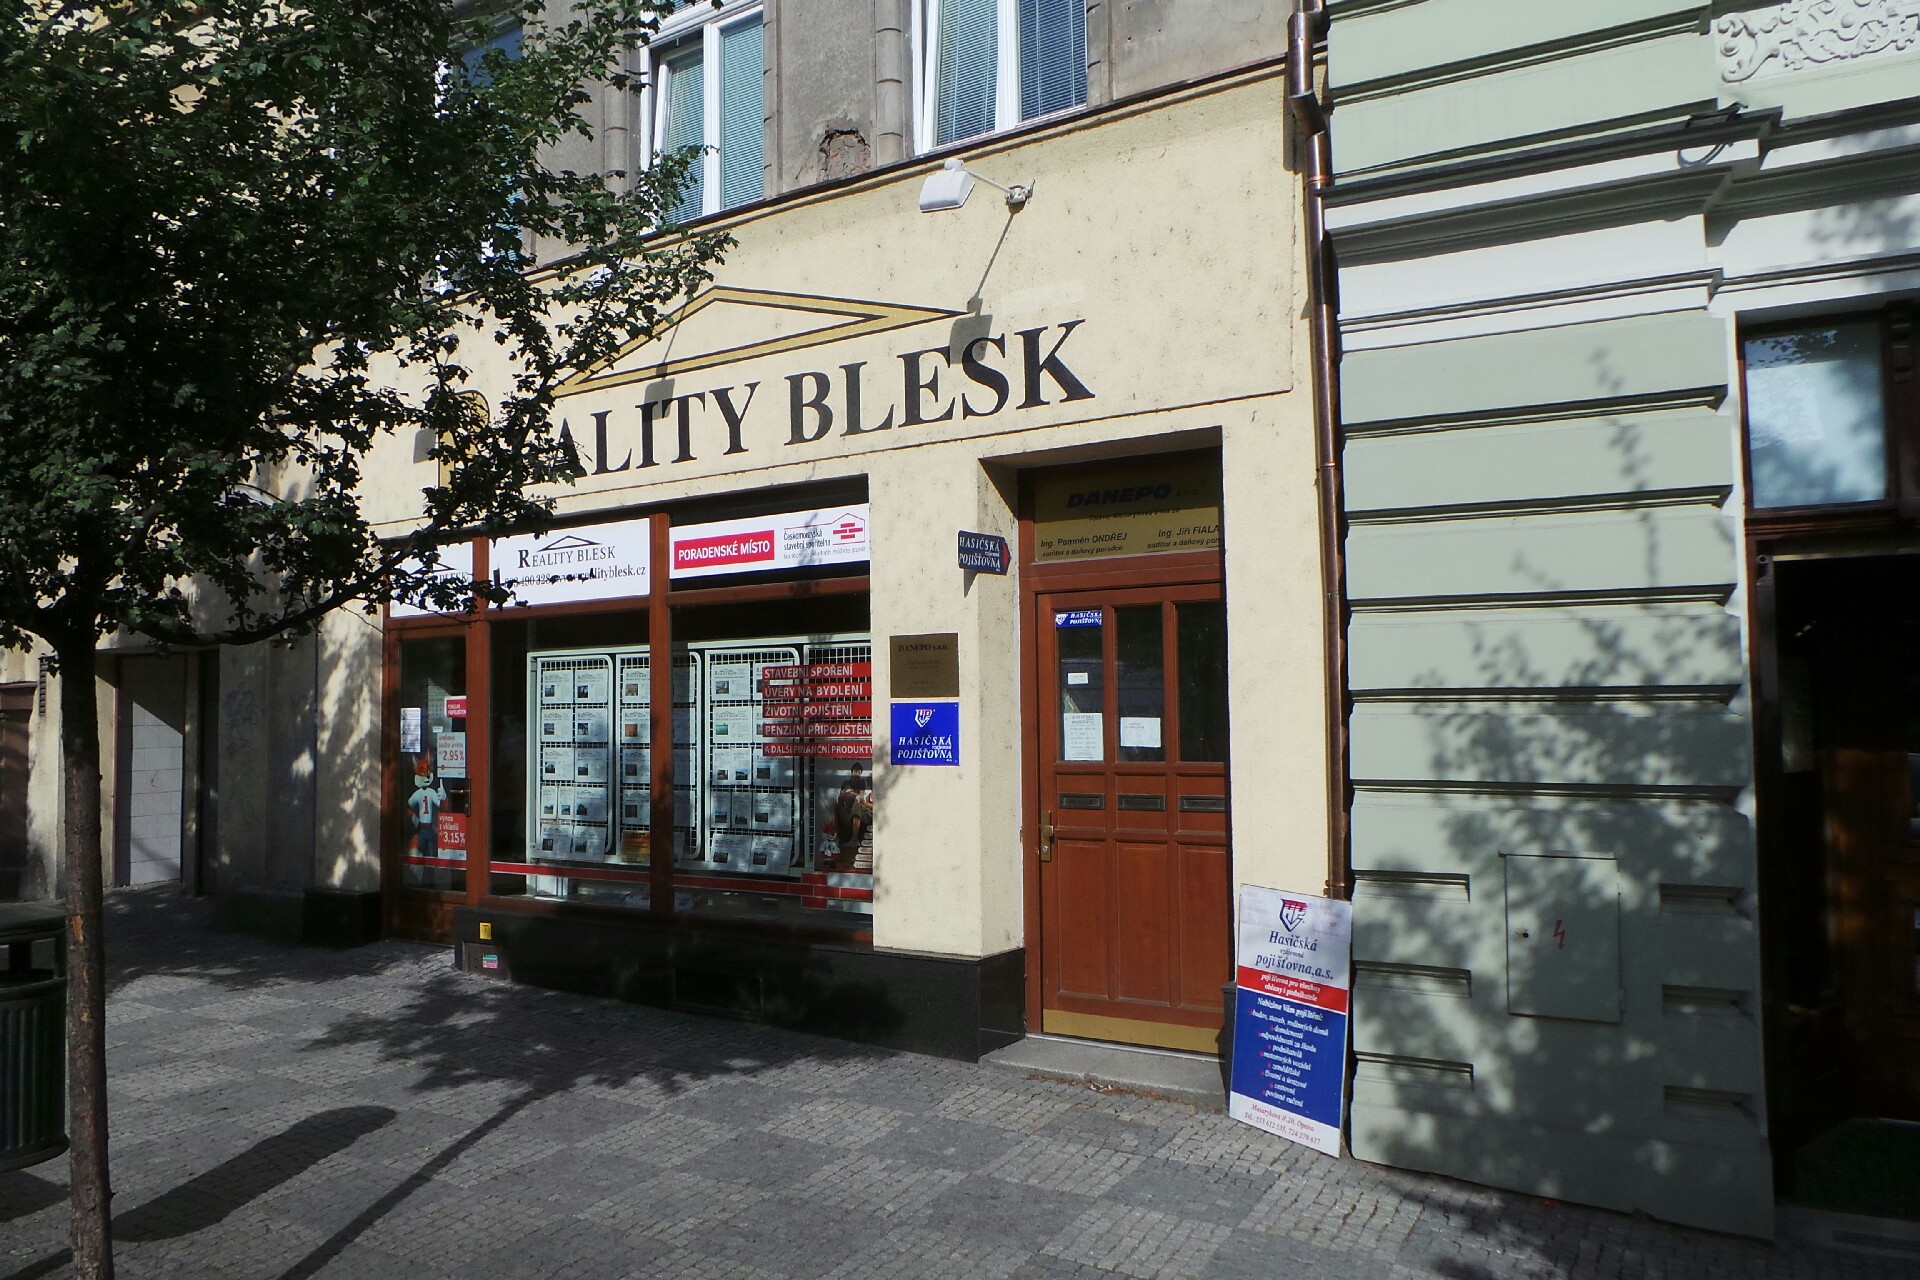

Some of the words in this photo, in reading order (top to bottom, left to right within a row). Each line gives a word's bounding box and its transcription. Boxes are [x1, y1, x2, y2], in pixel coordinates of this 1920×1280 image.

[784, 318, 1096, 446] BLESK
[1066, 484, 1172, 508] DANEPO
[1158, 529, 1174, 539] Ing.
[1176, 527, 1190, 536] Jiří
[1192, 524, 1220, 534] FIALA
[783, 540, 804, 551] stavební
[959, 536, 1000, 552] HASIČSKÁ
[1040, 539, 1055, 549] Ing.
[1092, 532, 1128, 543] ONDŘEJ
[678, 541, 739, 562] PORADENSKÉ
[740, 538, 770, 555] MÍSTO
[1095, 544, 1123, 554] poradce
[517, 549, 574, 568] REALITY
[577, 546, 616, 562] BLESK
[959, 552, 1001, 568] POJIŠŤOVNA
[764, 666, 809, 679] STAVEBNÍ
[810, 663, 853, 677] SPOŘENÍ
[765, 685, 795, 697] ÚVĚRY
[798, 686, 812, 697] NA
[816, 683, 863, 696] BYDLENÍ
[765, 703, 802, 717] ŽIVOTNÍ
[803, 702, 852, 716] POJIŠTĚNÍ
[765, 723, 806, 736] PENZIJNÍ
[898, 734, 952, 746] HASIČSKÁ
[771, 744, 792, 754] DALŠÍ
[793, 744, 830, 754] FINANČNÍ
[831, 744, 873, 754] PRODUKTY
[897, 747, 953, 759] POJIŠŤOVNA
[1269, 930, 1318, 952] Hasičská
[1288, 980, 1299, 988] pro
